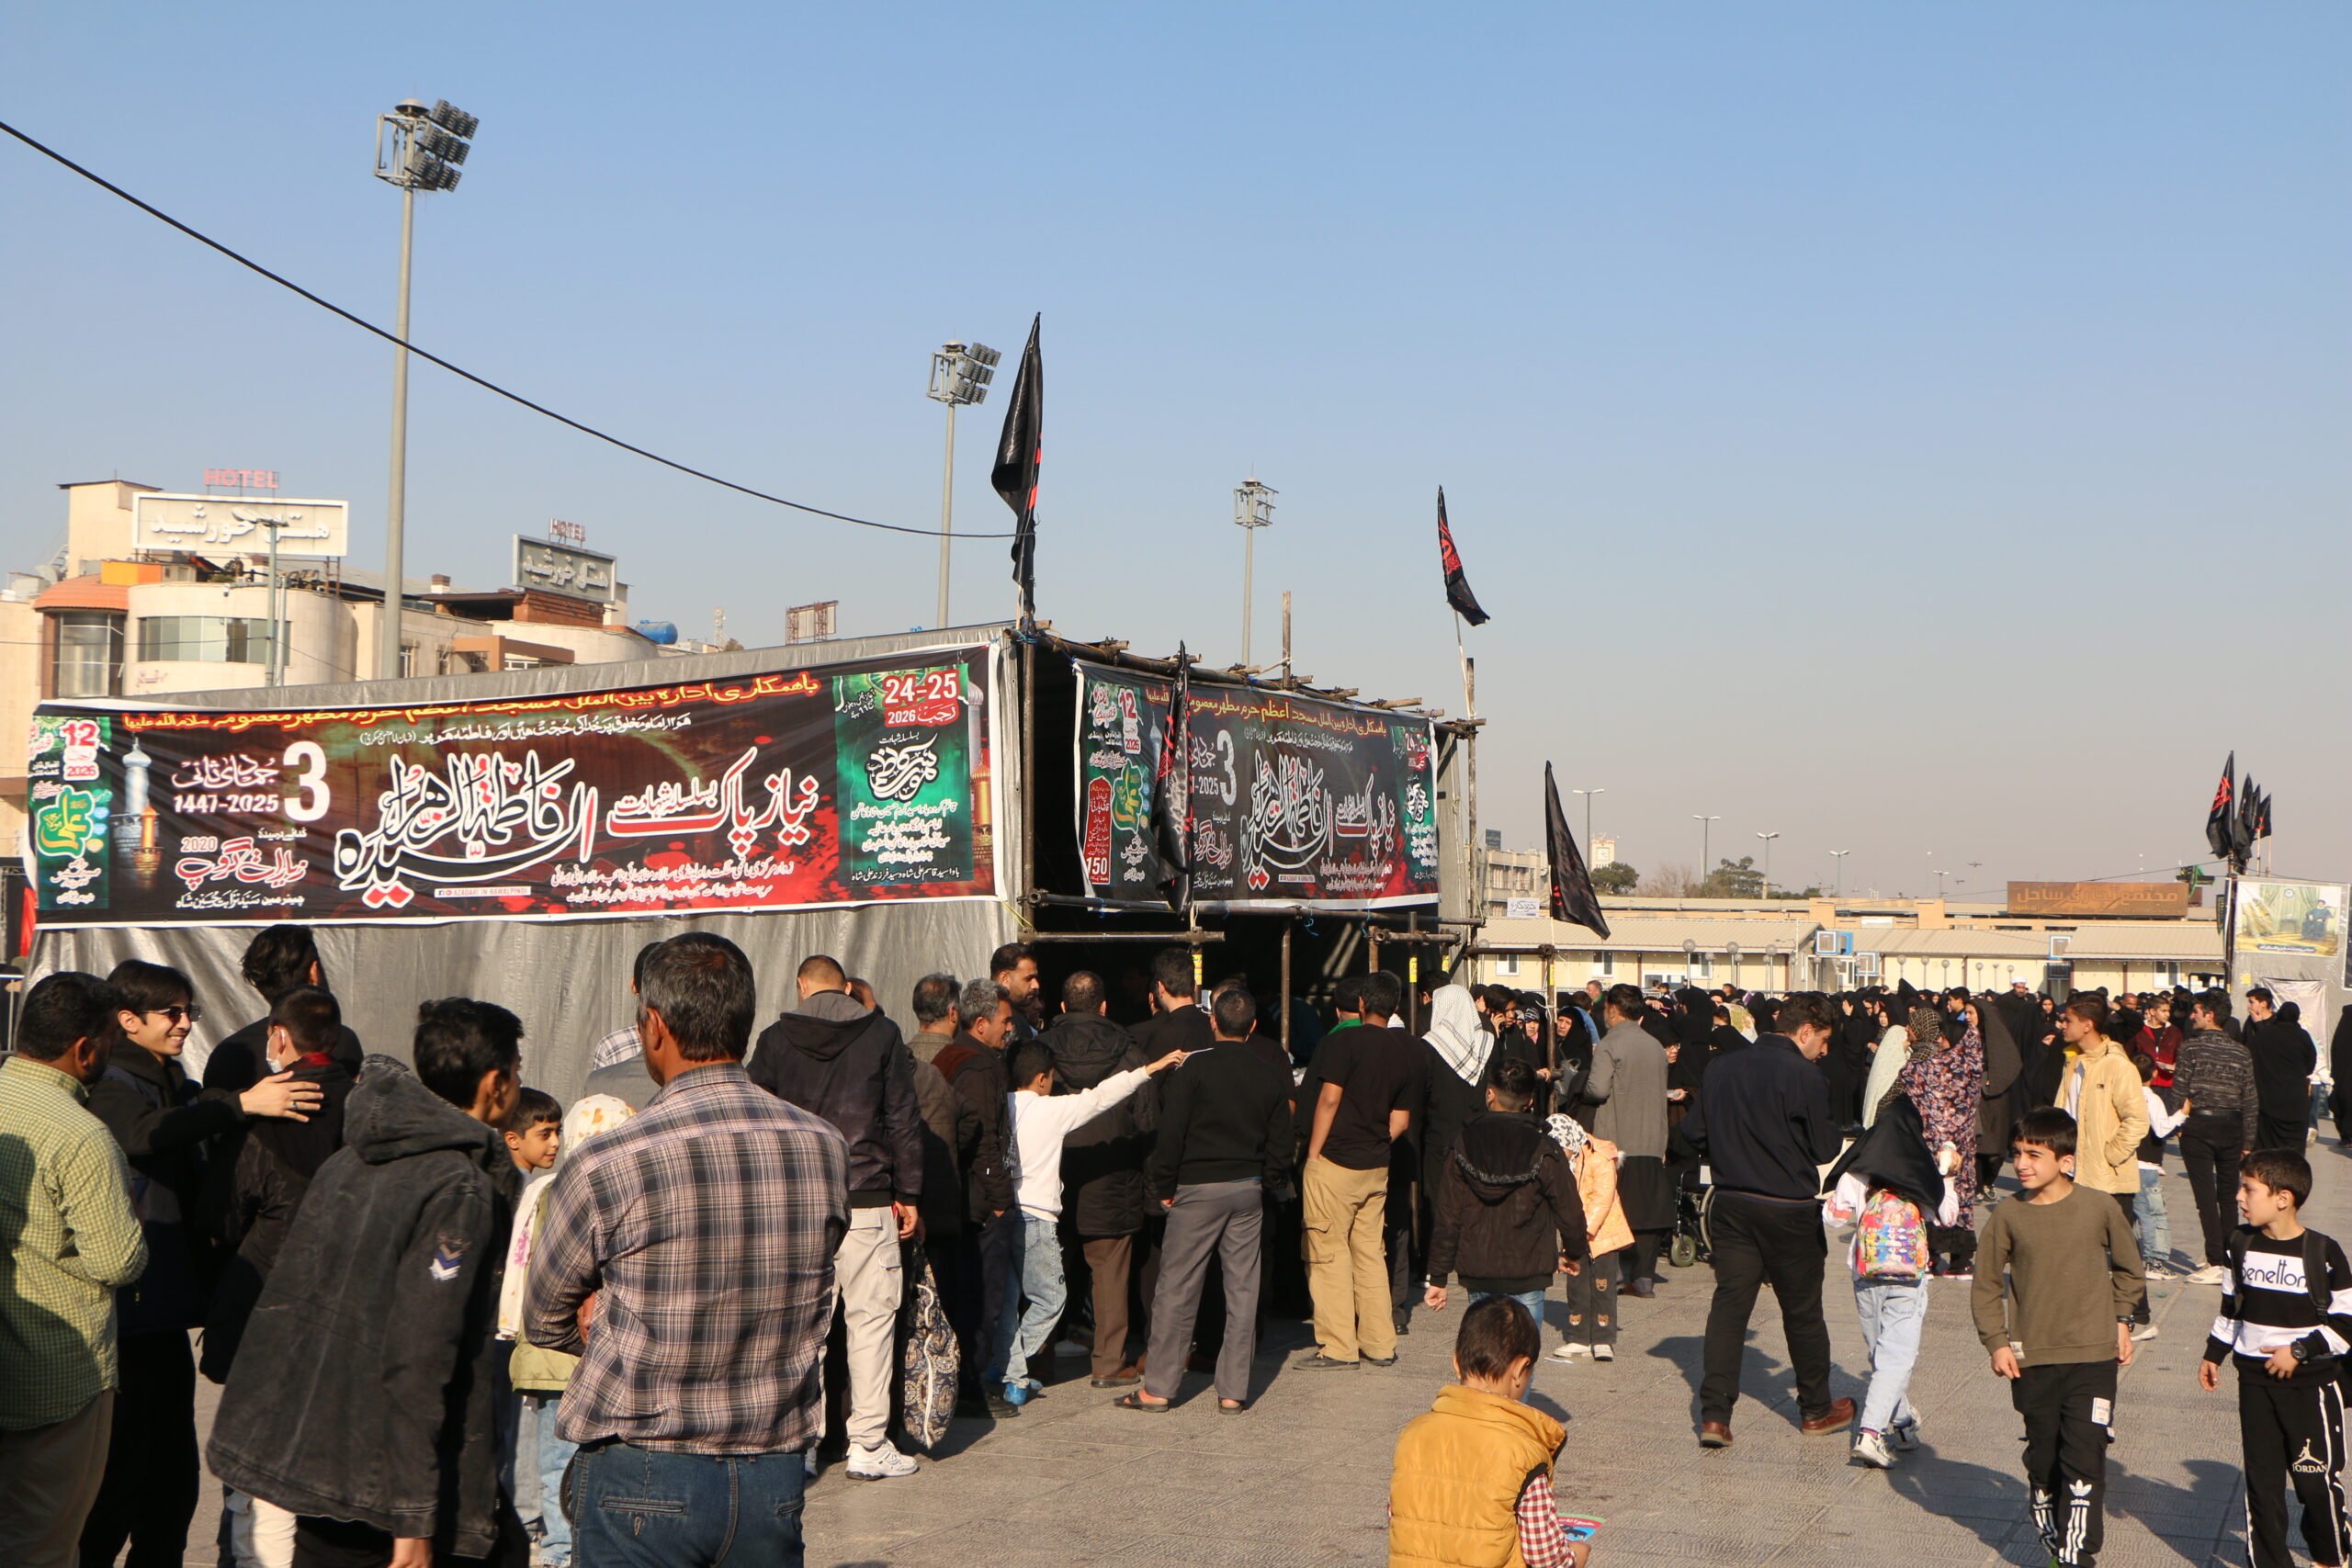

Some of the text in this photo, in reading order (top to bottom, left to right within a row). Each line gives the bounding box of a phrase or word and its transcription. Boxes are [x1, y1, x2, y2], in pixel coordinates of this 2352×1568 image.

[204, 468, 279, 488] HOTEL
[549, 518, 585, 541] HOTEL
[523, 548, 608, 589] هتل خورشید
[884, 672, 957, 705] 24-25
[475, 698, 560, 715] مسجد
[614, 693, 655, 709] بین
[1119, 691, 1137, 718] 12
[350, 709, 402, 726] حرم
[888, 704, 957, 724] رجب 2026
[1240, 705, 1261, 720] حرم
[1260, 700, 1290, 724] اعظم
[1291, 709, 1317, 726] مسجد
[62, 722, 97, 746] 12
[67, 765, 96, 777] 2026
[1216, 729, 1237, 807] 3
[281, 739, 332, 823] 3
[173, 794, 280, 814] 1447-2025
[605, 746, 820, 857] نیاز پاک
[181, 836, 219, 852] 2020
[175, 837, 254, 891] گروپ
[1086, 857, 1108, 875] 150
[489, 887, 528, 896] RAWALPINDI
[2016, 887, 2064, 903] ساحل
[2121, 887, 2178, 907] مجتمع
[2292, 1463, 2328, 1473] JORDAN
